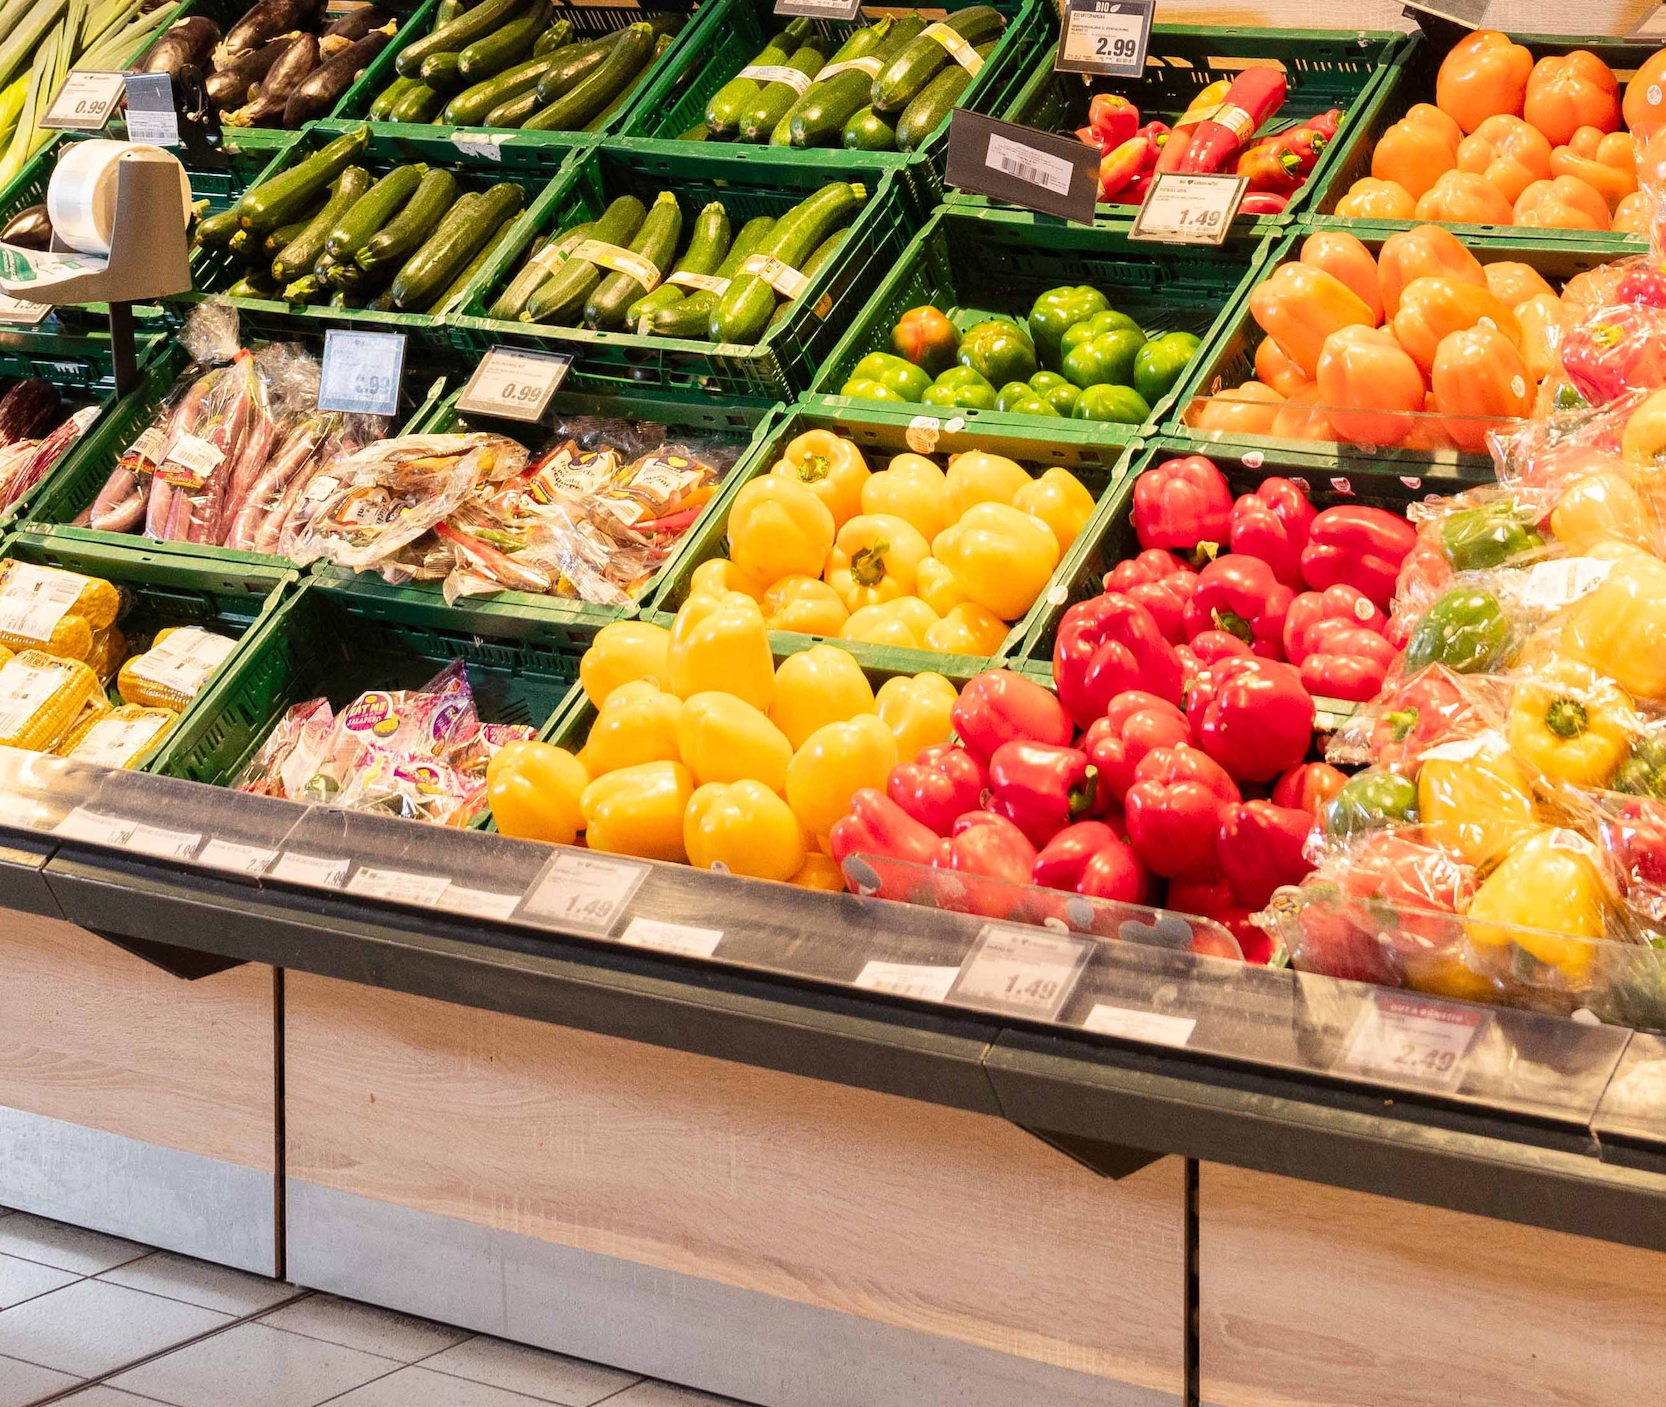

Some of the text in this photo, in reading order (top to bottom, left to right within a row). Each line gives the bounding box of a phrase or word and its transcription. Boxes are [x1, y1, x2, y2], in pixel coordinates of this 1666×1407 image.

[1095, 1, 1110, 12] BIO
[1096, 37, 1136, 58] 2.99
[75, 100, 107, 114] 0.99
[1179, 208, 1221, 227] 1.49
[502, 383, 542, 403] 0.99
[348, 701, 386, 717] EAT ME
[564, 893, 614, 919] 1.49
[1005, 973, 1059, 1000] 1.49
[1394, 1044, 1456, 1072] 2.49
